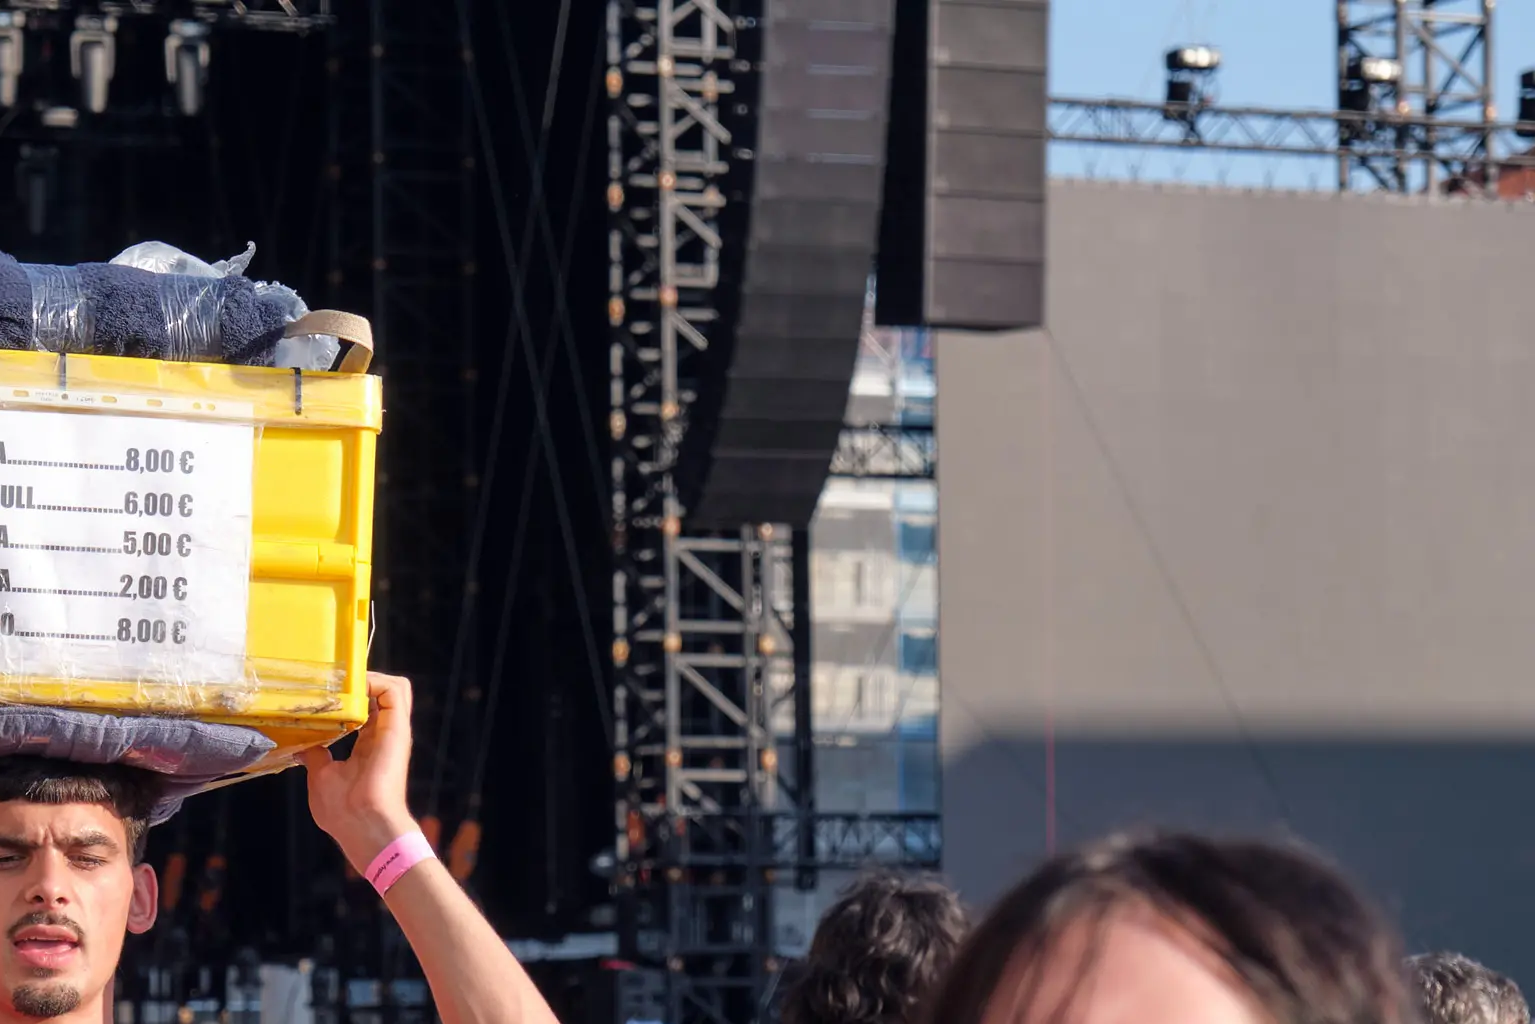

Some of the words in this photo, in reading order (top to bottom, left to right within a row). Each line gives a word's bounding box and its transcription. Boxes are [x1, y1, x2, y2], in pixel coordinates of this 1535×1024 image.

[125, 447, 174, 474] 8,00
[124, 491, 173, 517] 6,00
[123, 530, 172, 557] 5,00
[119, 574, 167, 600] 2,00
[117, 618, 166, 644] 8,00
